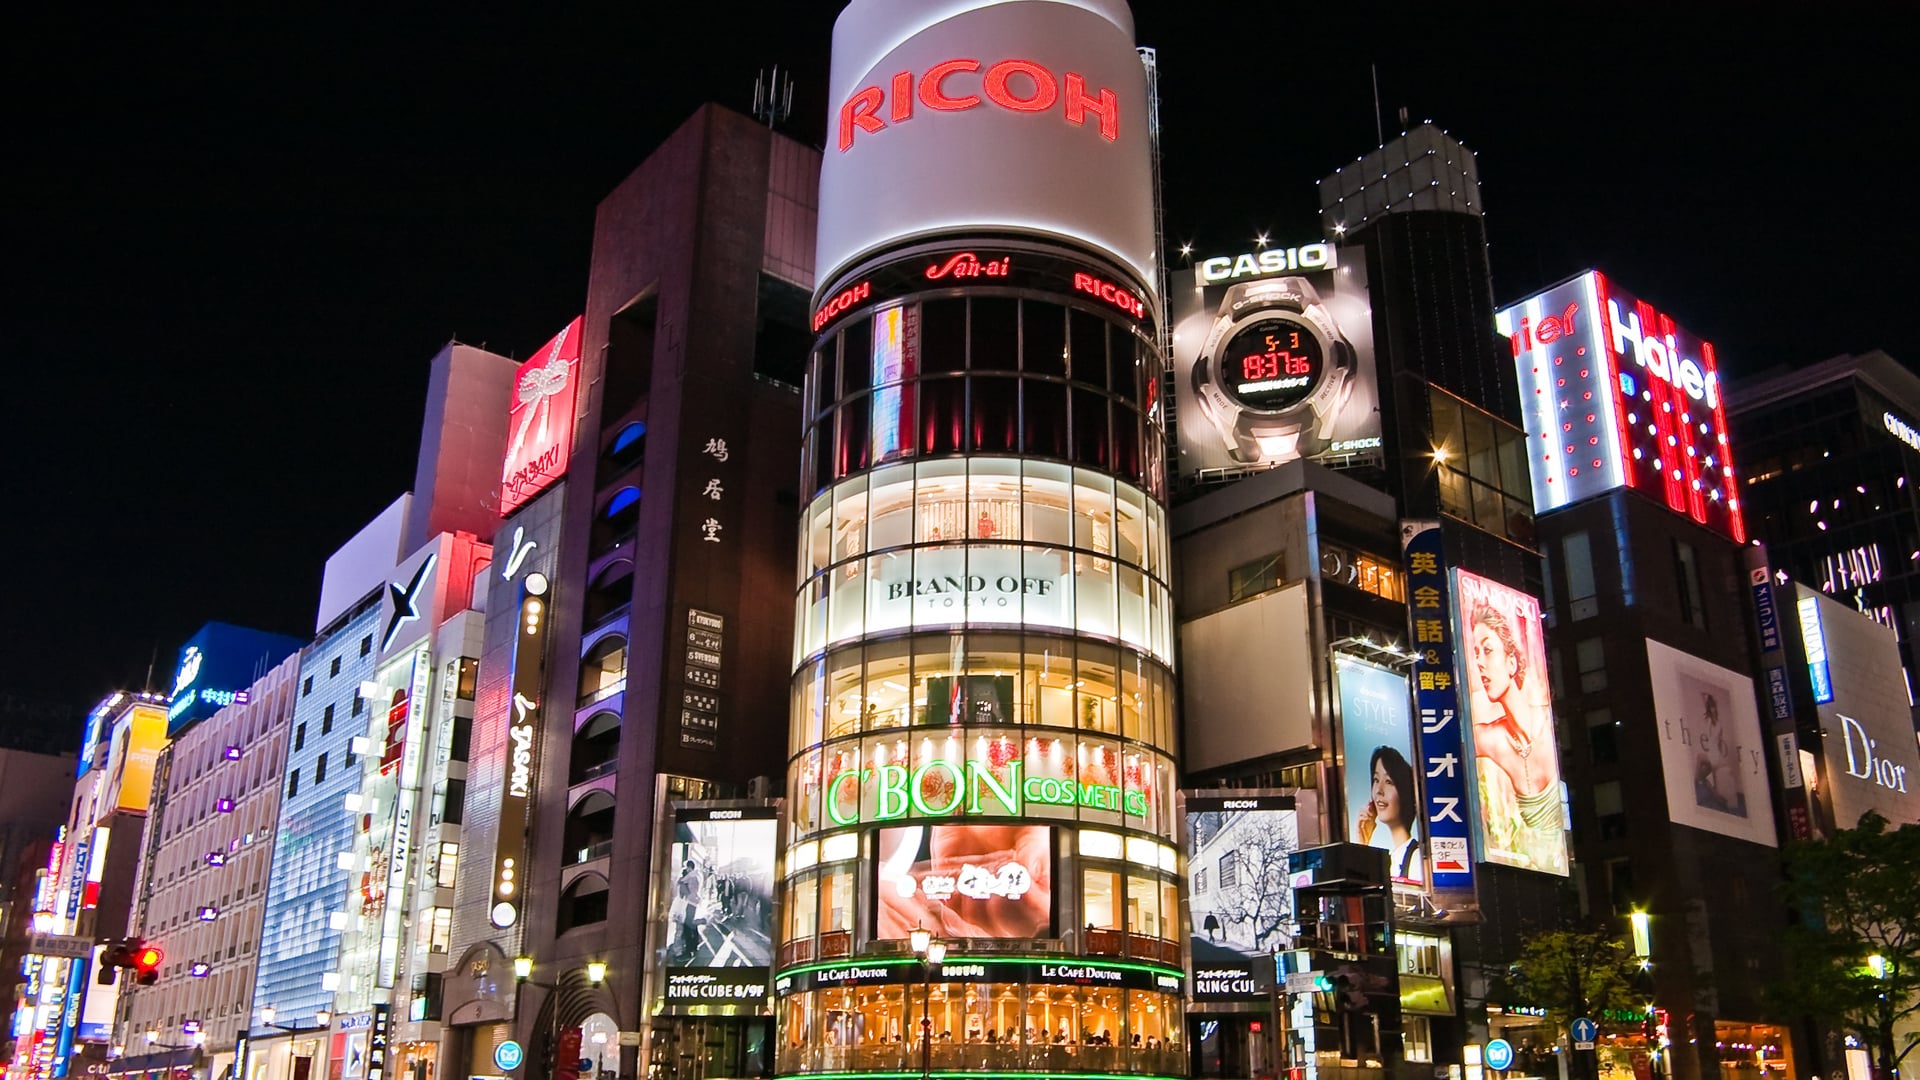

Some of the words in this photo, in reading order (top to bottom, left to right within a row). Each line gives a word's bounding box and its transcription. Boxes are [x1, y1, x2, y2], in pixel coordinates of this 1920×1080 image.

[838, 58, 1120, 155] RICOH
[925, 252, 1010, 279] San-ai
[1203, 243, 1328, 282] CASIO
[813, 281, 870, 331] RICOH
[1074, 272, 1144, 320] RICOH
[1232, 292, 1301, 310] G-SHOCK
[1608, 299, 1718, 409] Haier
[1331, 437, 1383, 451] G-SHOCK
[702, 438, 729, 542] 鳩居堂
[888, 575, 986, 602] BRAND
[996, 575, 1055, 597] OFF
[929, 596, 1009, 609] TOKYO
[1461, 576, 1537, 622] SWAROVSKI
[1352, 696, 1398, 727] STYLE
[510, 725, 533, 797] TASAKI
[1420, 708, 1463, 823] ジオス
[1836, 713, 1907, 793] Dior
[827, 758, 1023, 826] C'BON
[1023, 776, 1148, 816] COSMETCS
[1223, 800, 1258, 810] RICOH
[709, 810, 742, 820] RICOH
[1438, 851, 1450, 860] 3F
[668, 984, 698, 998] RING
[700, 984, 733, 998] CUBE
[1196, 980, 1230, 993] RING
